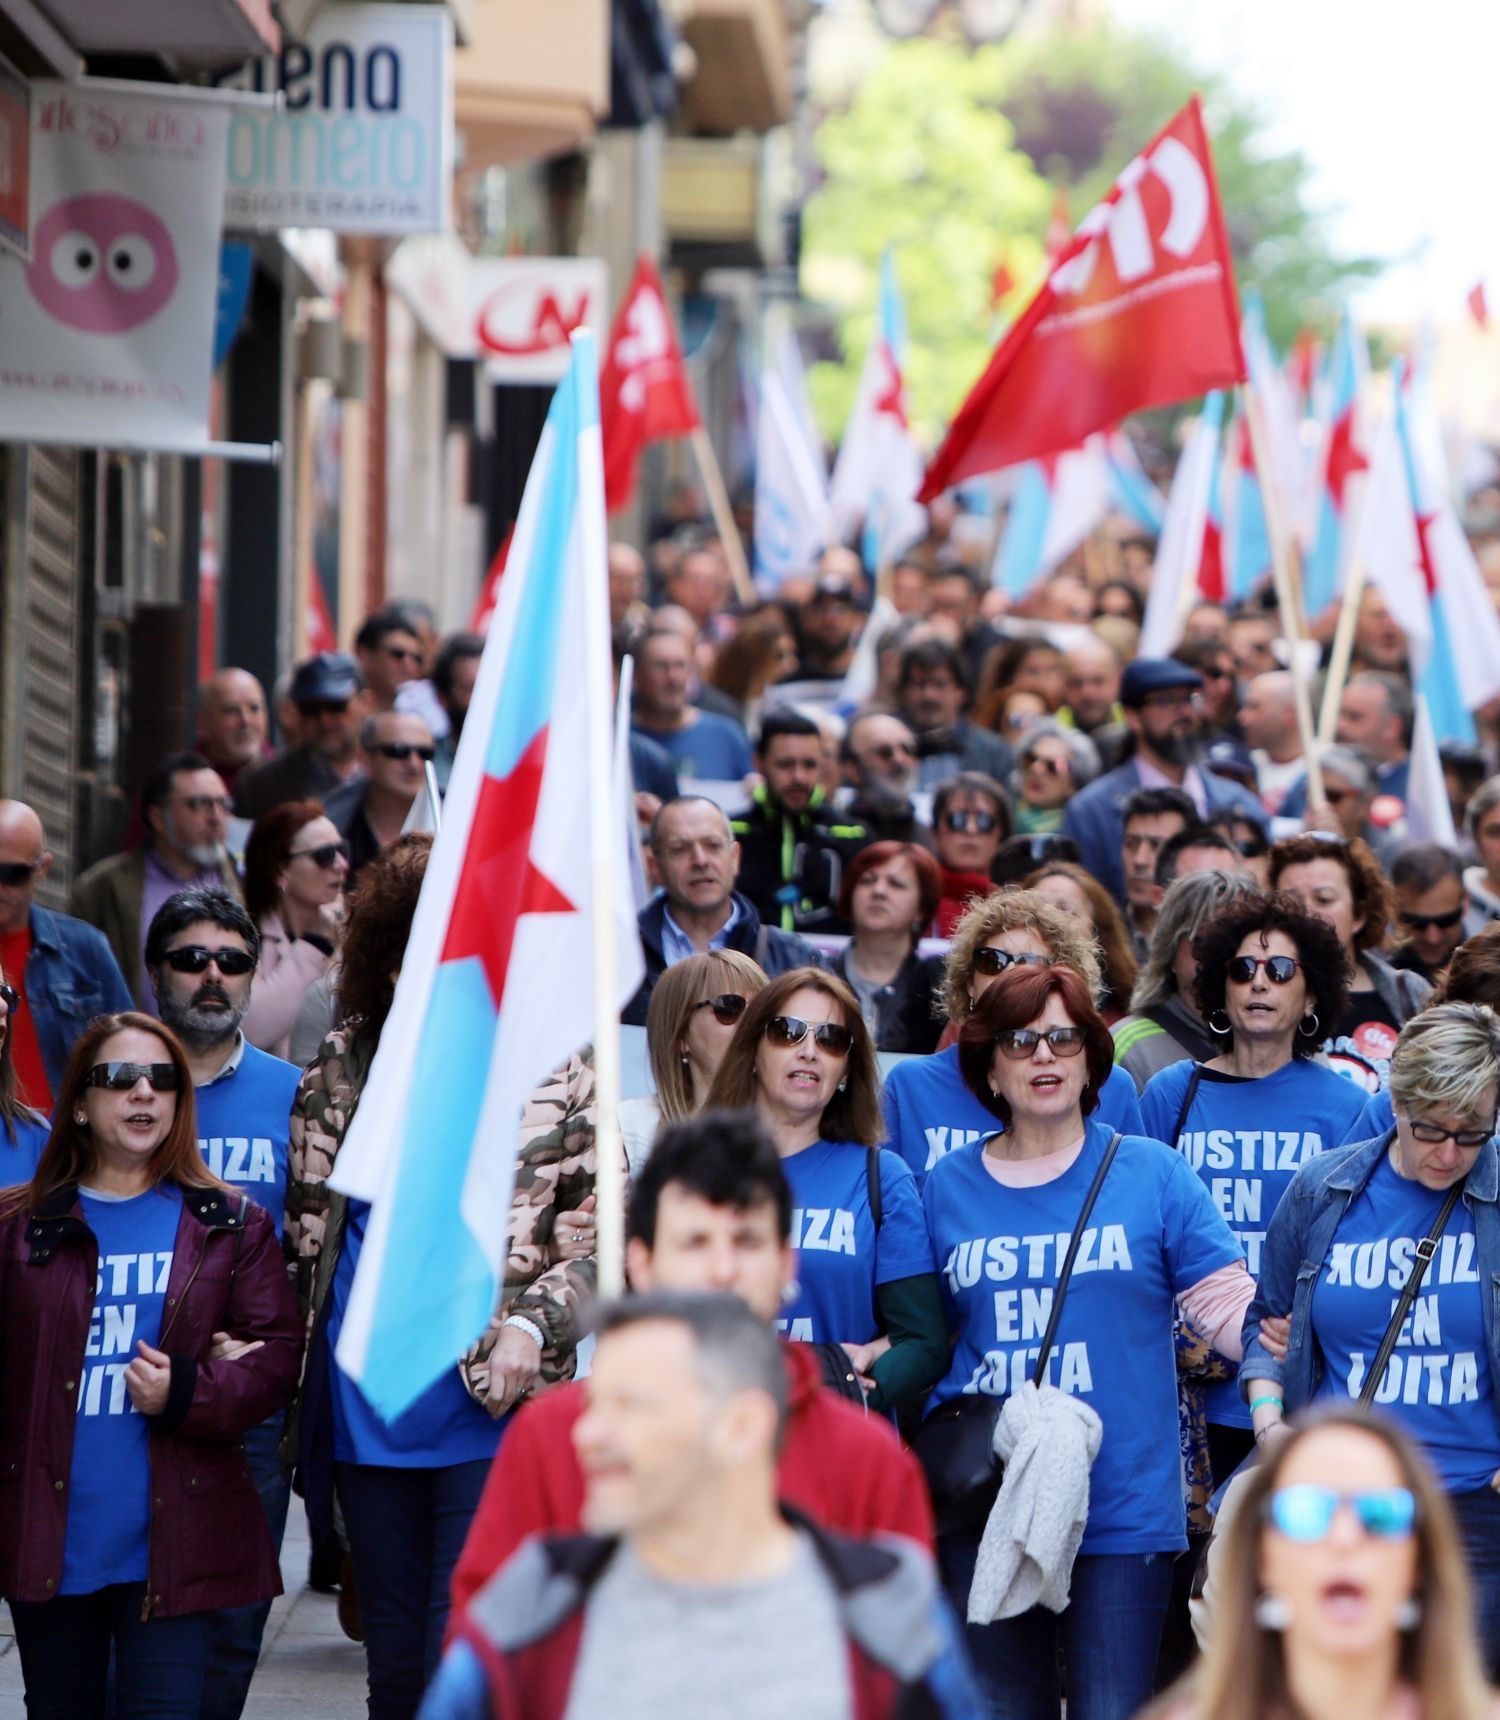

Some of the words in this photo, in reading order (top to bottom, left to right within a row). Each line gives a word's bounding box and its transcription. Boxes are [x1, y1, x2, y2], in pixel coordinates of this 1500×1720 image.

[226, 114, 425, 191] omero
[1211, 1178, 1263, 1223] EN
[1325, 1232, 1480, 1291] XUSIZ
[84, 1304, 137, 1357] EN
[994, 1287, 1054, 1342] EN
